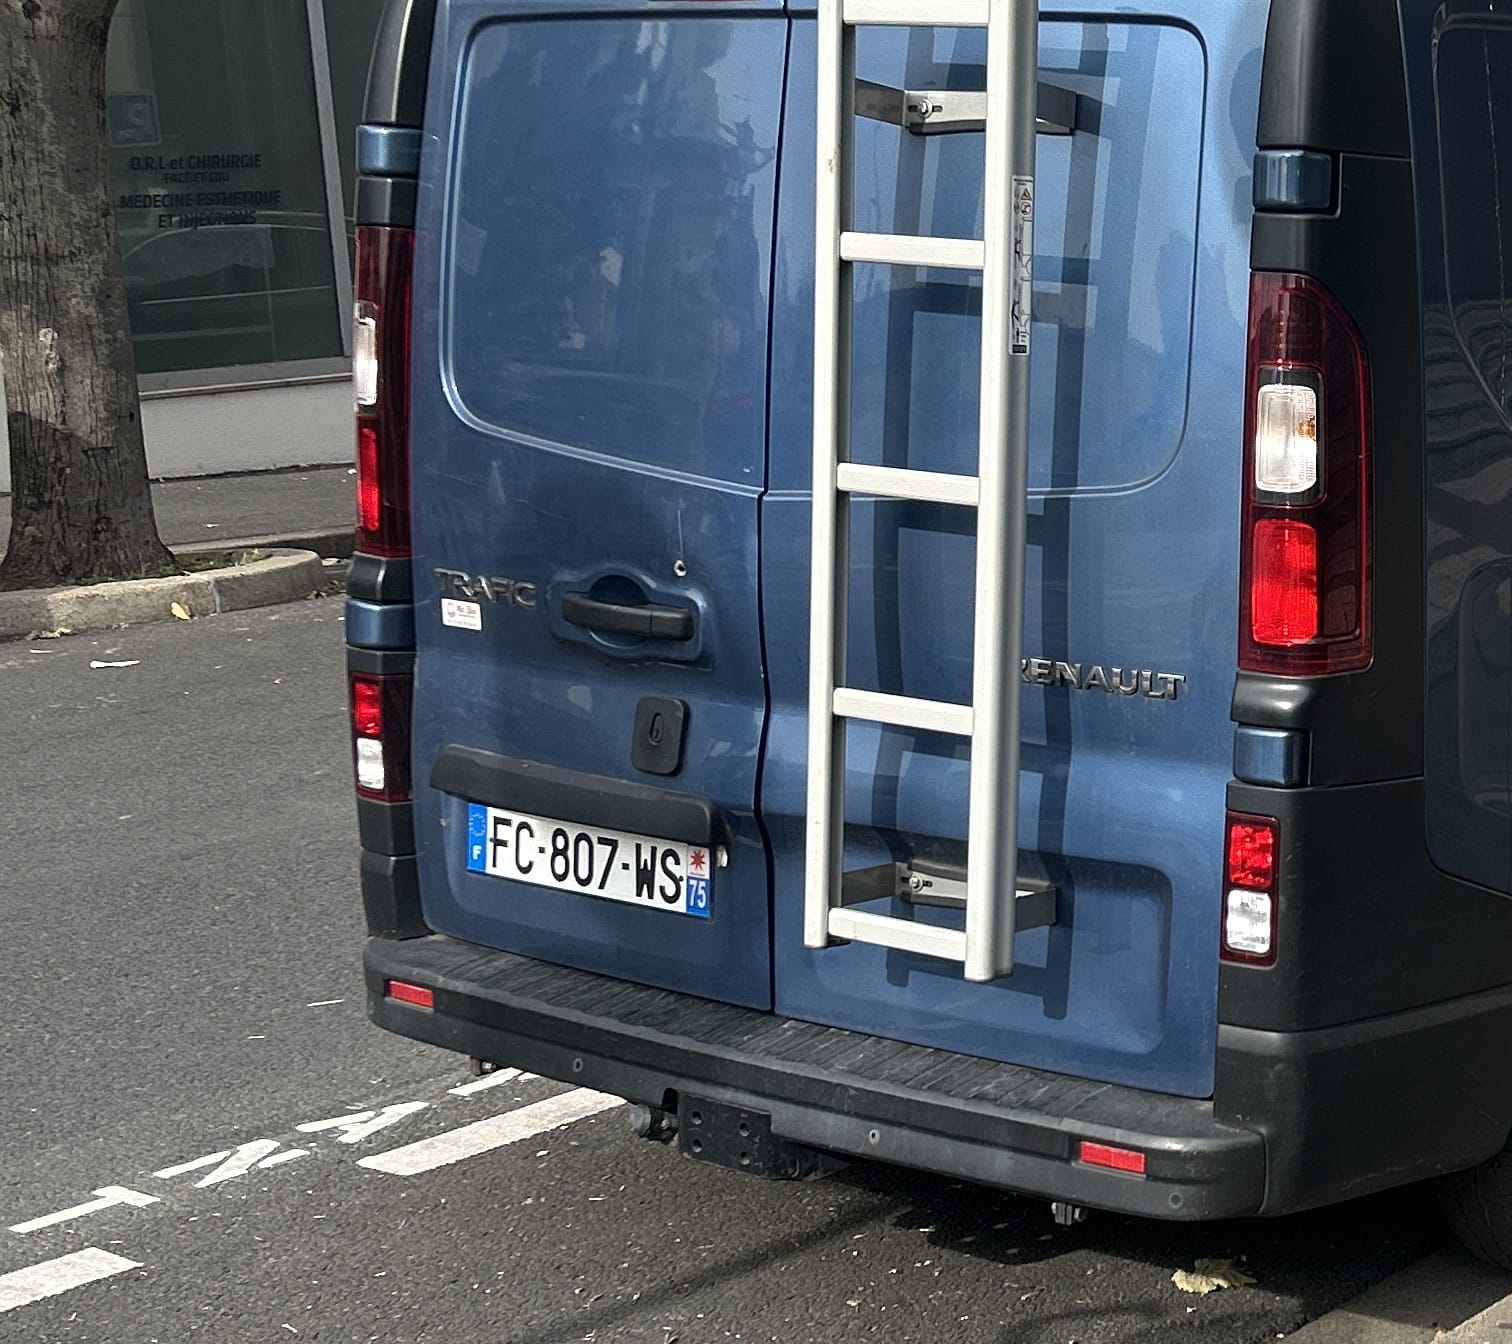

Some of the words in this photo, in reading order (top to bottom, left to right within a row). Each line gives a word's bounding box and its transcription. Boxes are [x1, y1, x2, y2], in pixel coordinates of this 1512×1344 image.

[169, 155, 185, 170] et
[186, 153, 263, 170] CHIRURGIE
[158, 213, 174, 229] ET
[433, 567, 537, 610] TRAFIC
[471, 844, 482, 860] F
[489, 815, 684, 905] FC-807-WS
[688, 877, 708, 910] 75
